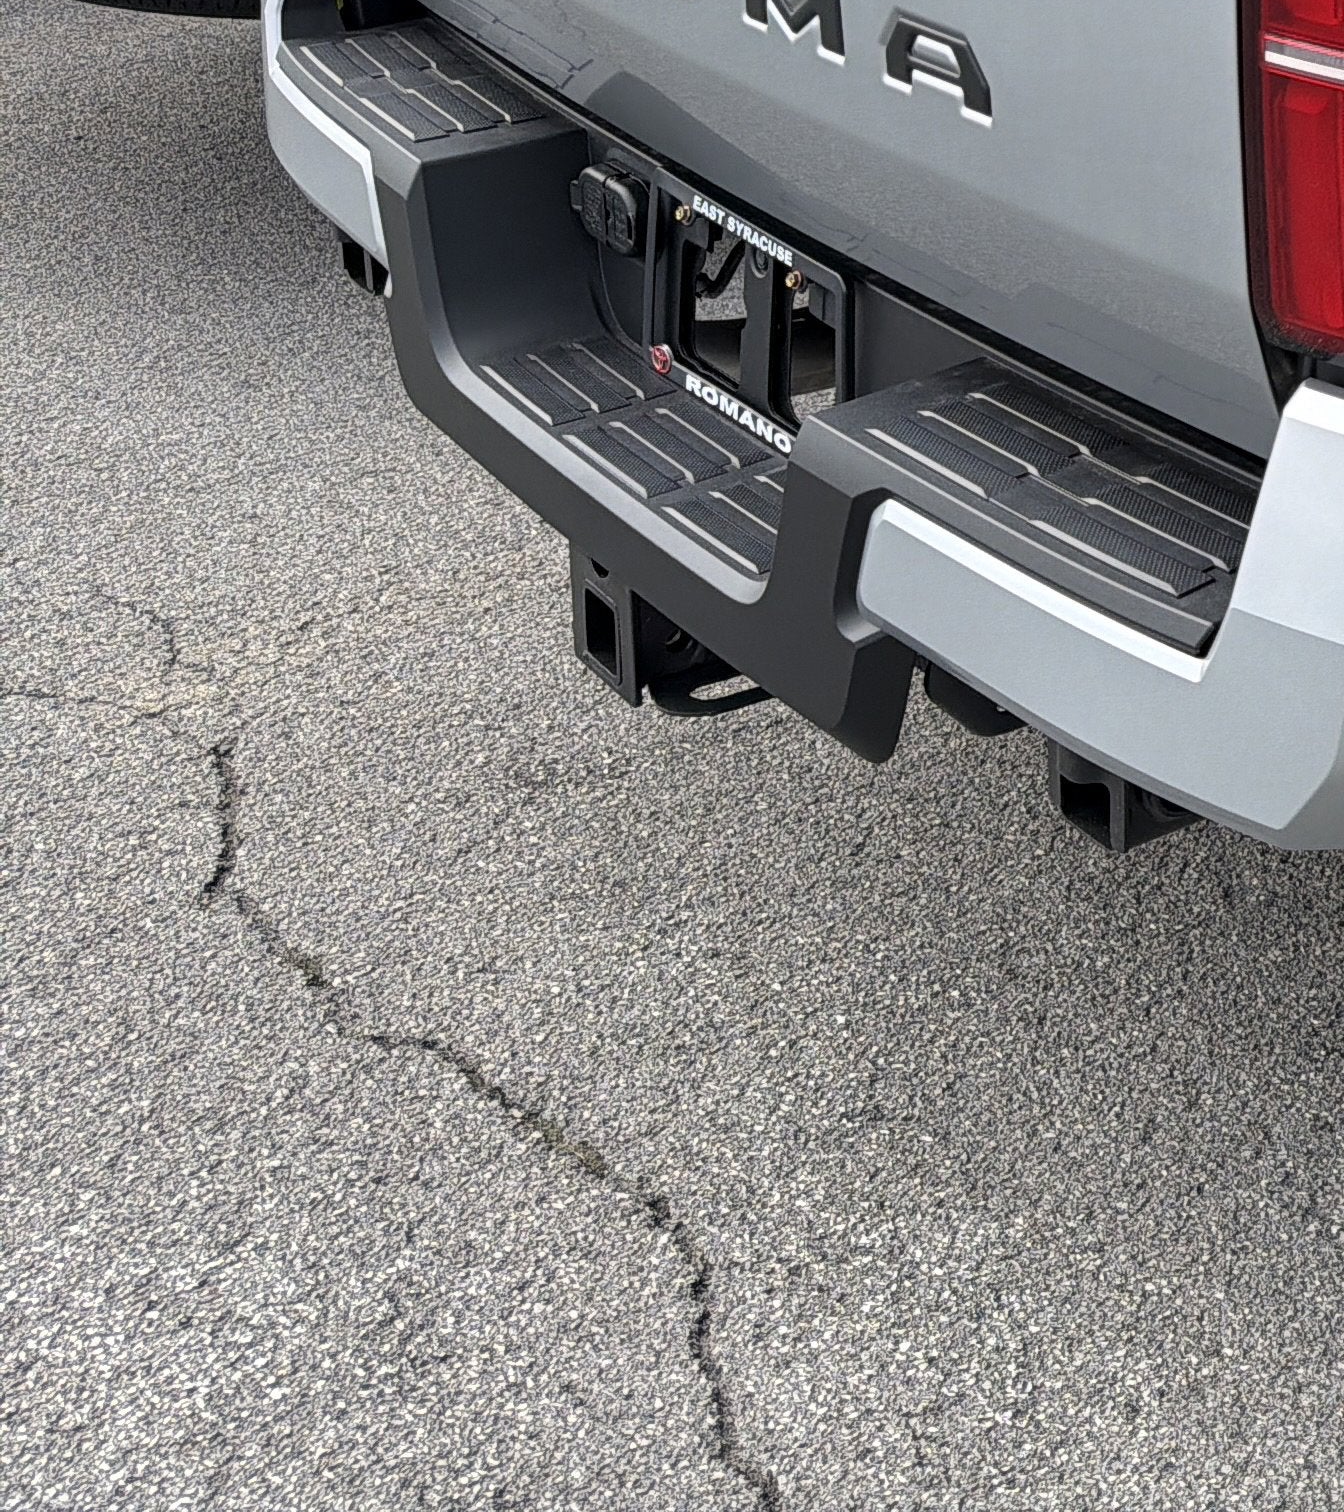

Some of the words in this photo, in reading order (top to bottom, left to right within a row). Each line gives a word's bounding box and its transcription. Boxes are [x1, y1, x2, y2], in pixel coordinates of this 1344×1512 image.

[692, 194, 727, 227] EAST
[726, 216, 793, 267] SYRACUSE
[684, 373, 793, 454] ROMANO
